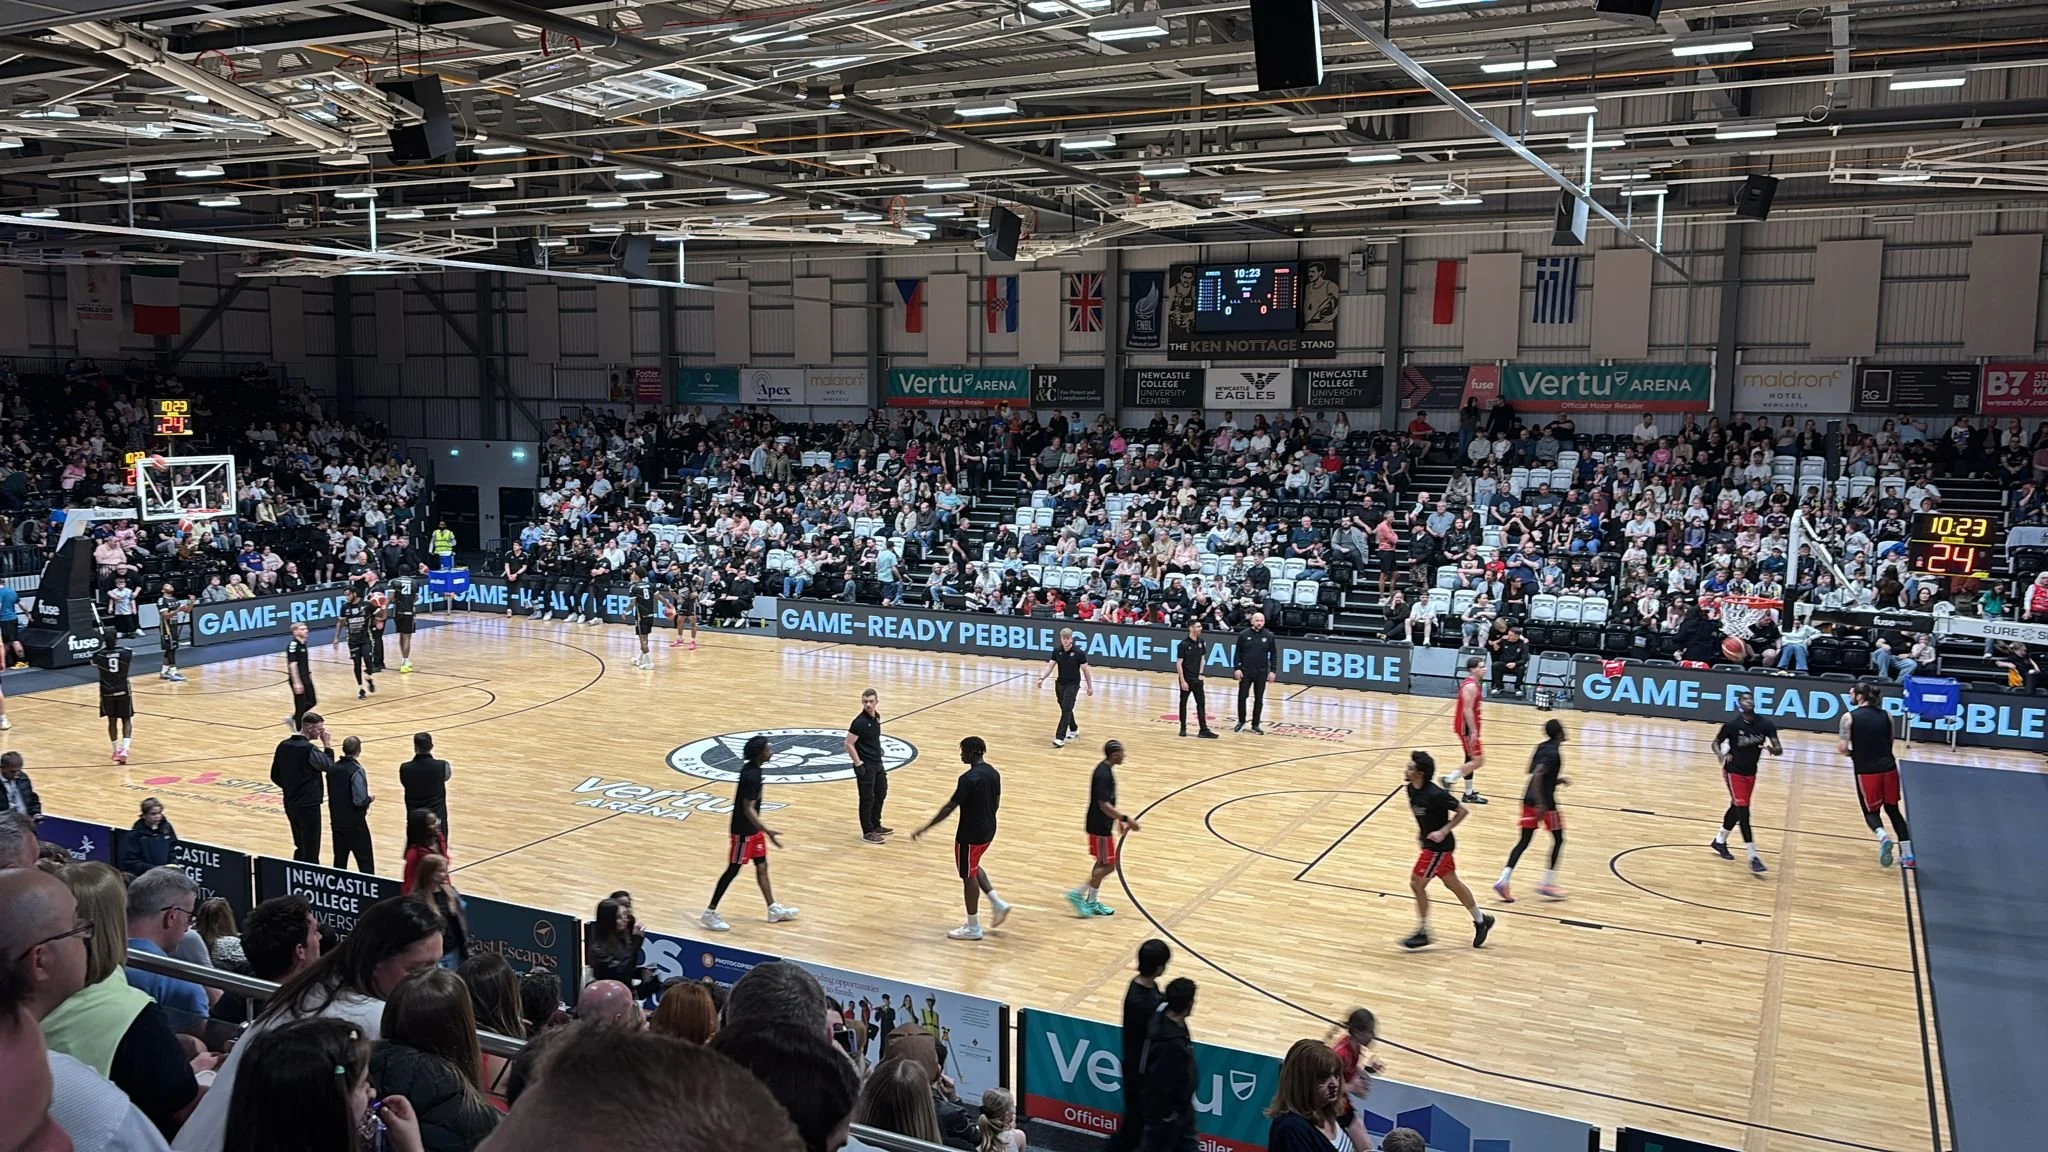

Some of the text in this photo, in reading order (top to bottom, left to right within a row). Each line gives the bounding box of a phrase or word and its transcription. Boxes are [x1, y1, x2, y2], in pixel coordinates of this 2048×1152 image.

[1234, 268, 1261, 278] 10:23
[1225, 306, 1232, 315] 0
[1260, 305, 1267, 314] 0
[1136, 320, 1153, 331] ENBL
[1169, 339, 1335, 352] THE KEN NOTTAGE STAND
[810, 372, 861, 386] maldron
[1141, 371, 1191, 380] NEWCASTLE
[1312, 369, 1368, 378] NEWCASTLE
[1743, 370, 1833, 388] maldron
[899, 373, 1017, 394] Vertu ARENA
[1038, 375, 1057, 388] FP
[1140, 380, 1179, 388] COLLEGE
[1312, 379, 1355, 388] COLLEGE
[1471, 378, 1494, 389] fuse
[1518, 371, 1692, 396] Vertu ARENA
[758, 383, 791, 397] Apex
[1035, 388, 1057, 402] &C
[1140, 389, 1186, 397] UNIVERSITY
[1215, 391, 1276, 400] EAGLES
[1312, 388, 1364, 397] UNIVERSITY
[1861, 390, 1880, 400] RG
[1140, 397, 1171, 405] CENTRE
[1311, 397, 1346, 406] CENTRE
[1560, 401, 1645, 411] Official Motor Retailer
[162, 416, 184, 433] 24
[1930, 516, 1988, 538] 10:23
[1927, 544, 1975, 572] 24
[401, 583, 412, 595] 21
[643, 588, 650, 600] 8
[38, 599, 61, 616] fuse
[199, 596, 348, 636] GAME-REA
[1873, 615, 1897, 627] fuse
[1983, 625, 2020, 637] SURE
[68, 635, 100, 651] fuse
[781, 608, 954, 643] GAME-READY
[960, 622, 1054, 651] PEBBLE
[1282, 648, 1401, 683] PEBBLE
[73, 651, 94, 660] medi
[108, 657, 119, 673] 9
[1221, 717, 1353, 734] smpson
[757, 729, 906, 753] NEWCTLE
[677, 757, 833, 782] BASKEALL
[572, 776, 735, 813] Vertu
[574, 798, 692, 820] ARENA
[173, 845, 221, 868] CASTLE
[292, 868, 379, 899] NEWCASTLE
[499, 940, 558, 970] Escapes
[1046, 1031, 1224, 1116] Veu
[1063, 1107, 1233, 1152] Official ailer
